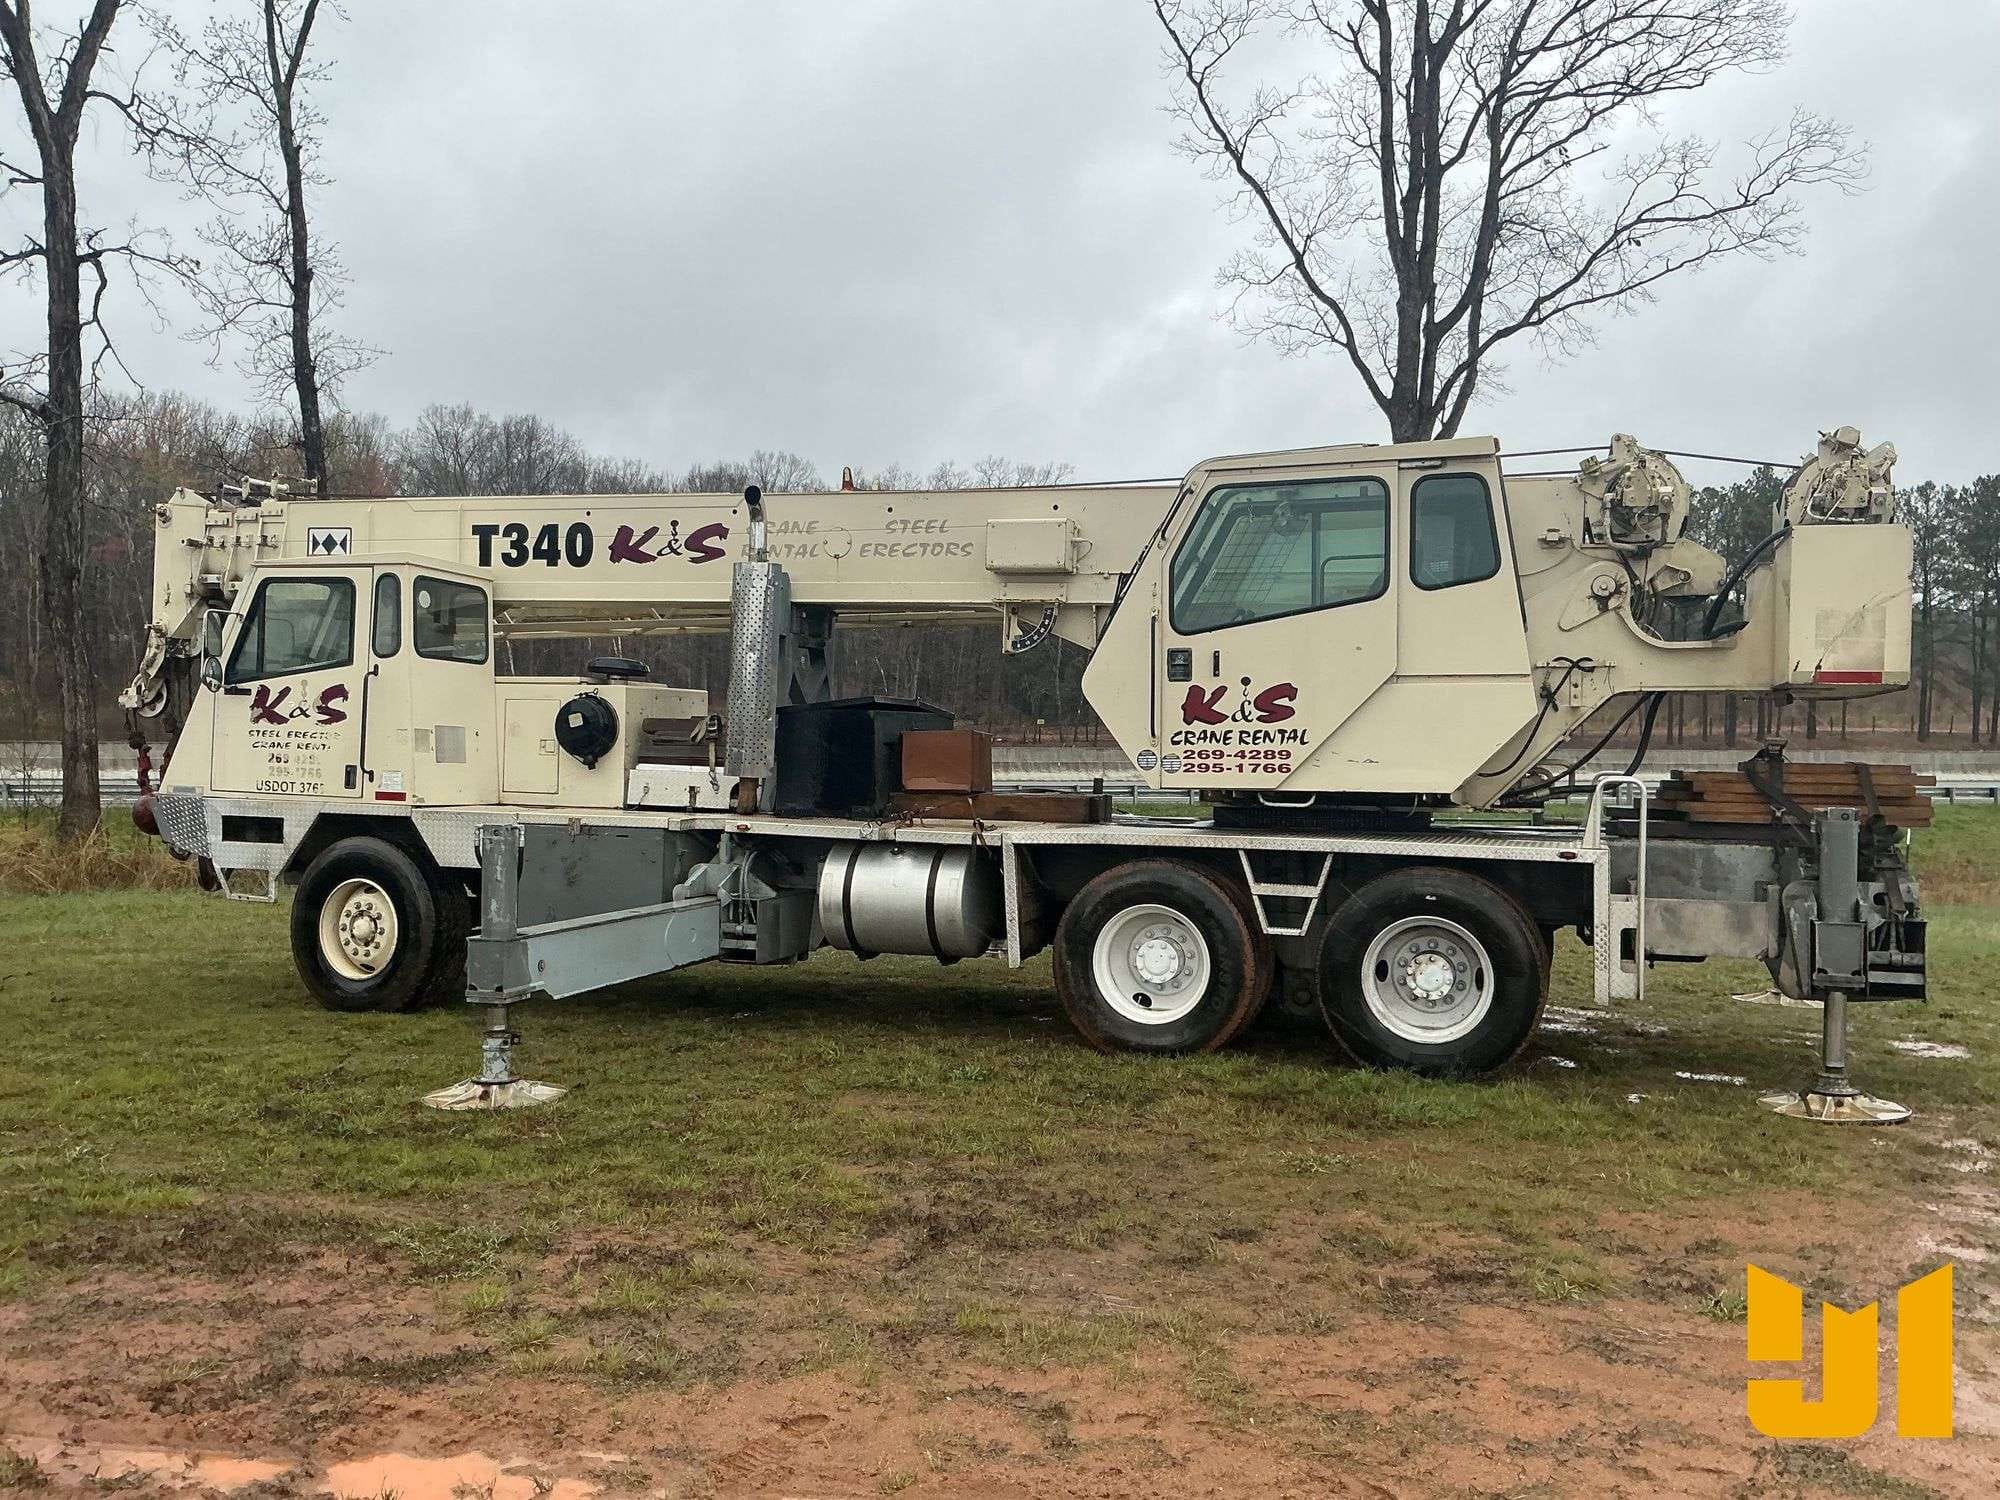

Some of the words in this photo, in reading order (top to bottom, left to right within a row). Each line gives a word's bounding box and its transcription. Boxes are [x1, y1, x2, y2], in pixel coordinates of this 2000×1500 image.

[747, 520, 819, 534] RANE
[885, 519, 951, 534] STEEL
[471, 522, 594, 568] T340
[741, 543, 820, 558] RNTAL
[860, 542, 974, 559] ERECTORS
[249, 730, 281, 738] STEEL
[1170, 730, 1233, 745] CRANE
[1238, 729, 1309, 745] RENTAL
[252, 741, 291, 750] CRANE
[1182, 750, 1292, 760] 269-4289
[1182, 763, 1292, 774] 295-1766
[256, 780, 296, 793] USDOT
